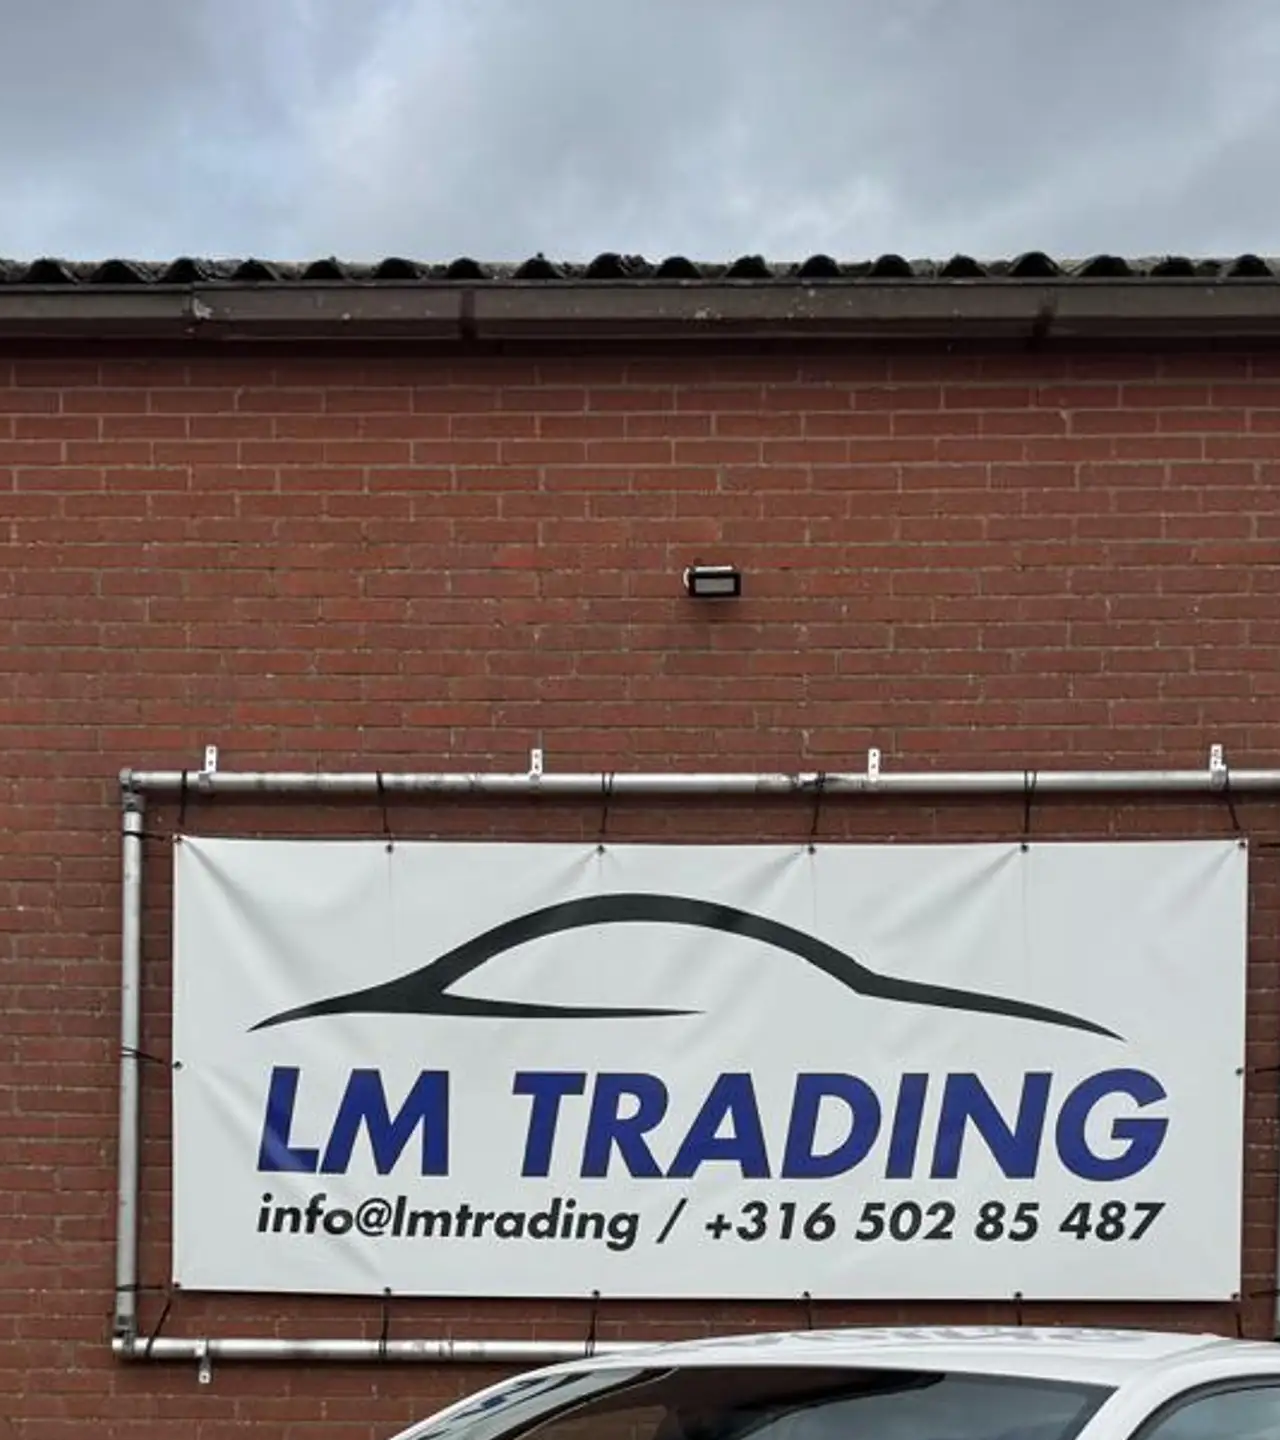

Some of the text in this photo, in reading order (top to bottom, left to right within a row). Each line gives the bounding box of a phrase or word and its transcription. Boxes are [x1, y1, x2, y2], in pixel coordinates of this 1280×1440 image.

[257, 1066, 1168, 1180] LM TRADING
[256, 1193, 639, 1251] info@lmtrading
[704, 1201, 837, 1242] +316
[854, 1201, 957, 1241] 502
[973, 1202, 1041, 1242] 85
[1058, 1202, 1167, 1242] 487
